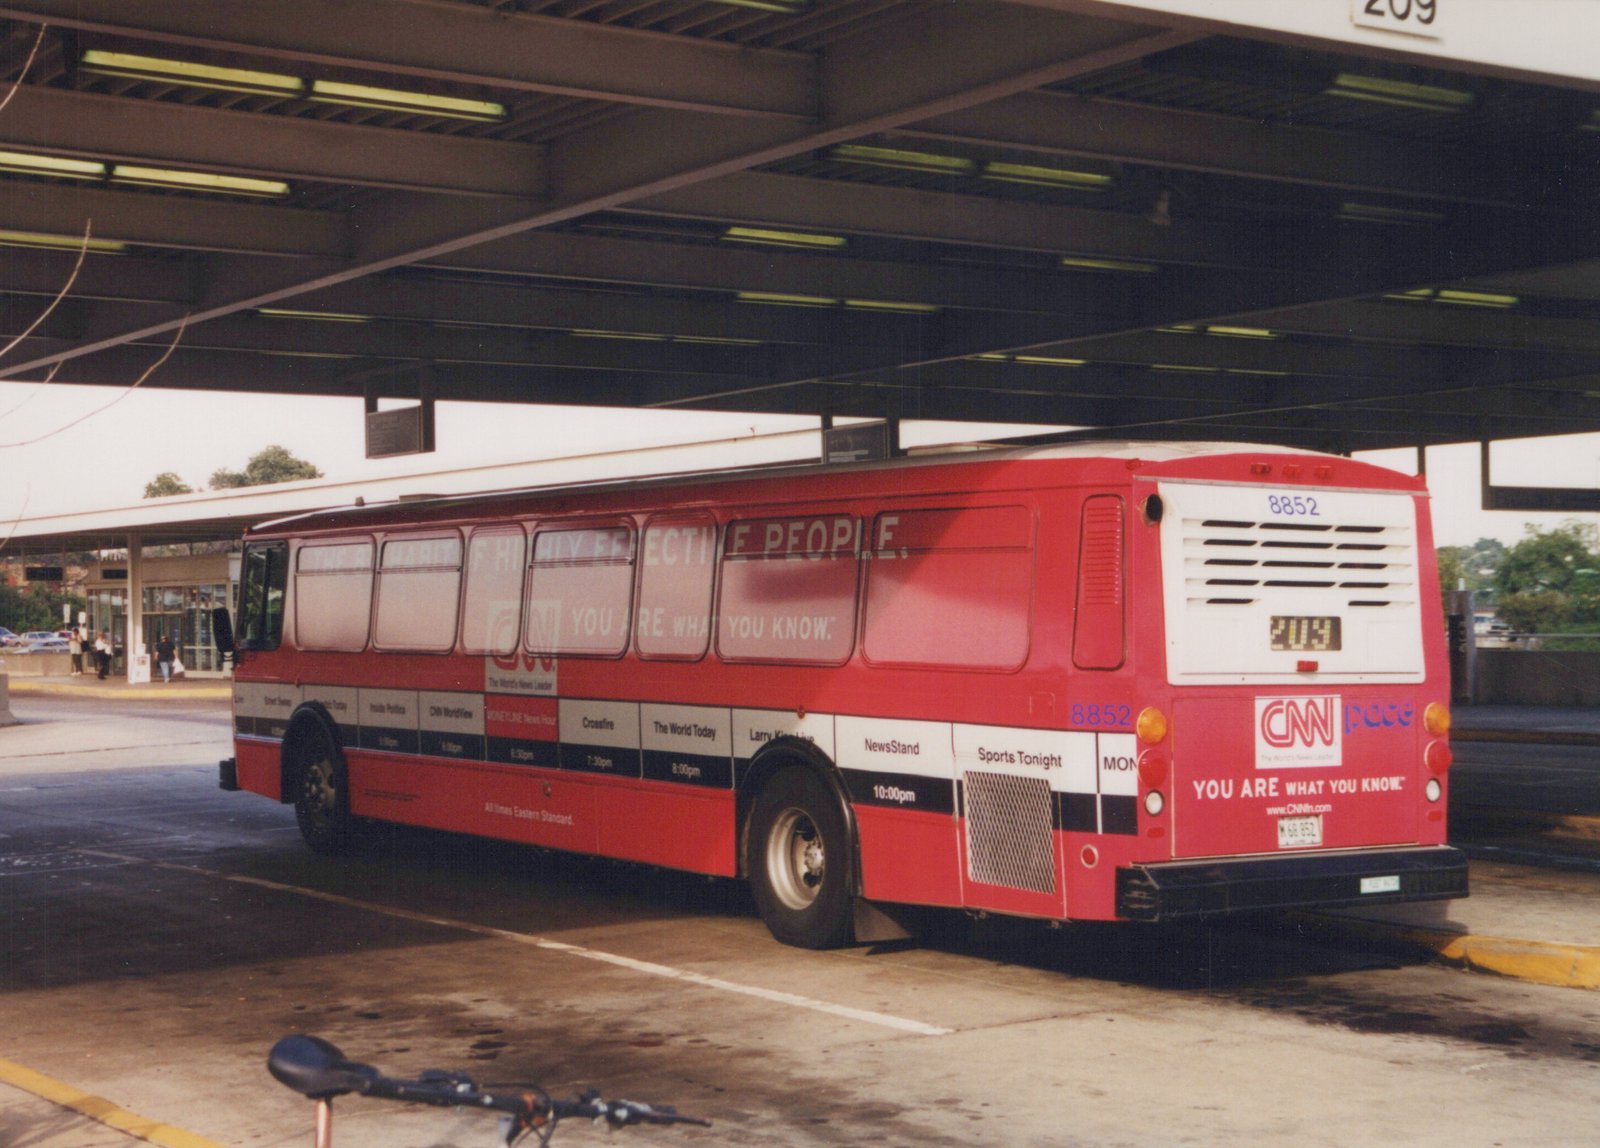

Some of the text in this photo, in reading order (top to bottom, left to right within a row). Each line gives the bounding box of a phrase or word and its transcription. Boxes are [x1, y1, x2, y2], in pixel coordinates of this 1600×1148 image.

[1268, 495, 1320, 516] 8852
[763, 516, 909, 562] PEOPLE.
[572, 607, 616, 636] YOU
[728, 616, 764, 639] YOU
[772, 616, 832, 640] KNOW.
[582, 716, 615, 731] Crossfire
[1071, 703, 1133, 727] 8852
[1260, 698, 1335, 748] CNN
[653, 720, 717, 741] The World Today
[749, 728, 773, 743] Larry
[864, 737, 920, 756] NewsStand
[977, 746, 1063, 770] Sports Tonight
[671, 762, 701, 779] 8:00pm
[872, 784, 915, 803] 10:00pm
[1192, 778, 1234, 800] YOU
[1240, 777, 1280, 798] ARE
[1285, 780, 1325, 796] WHAT
[1329, 779, 1357, 794] YOU
